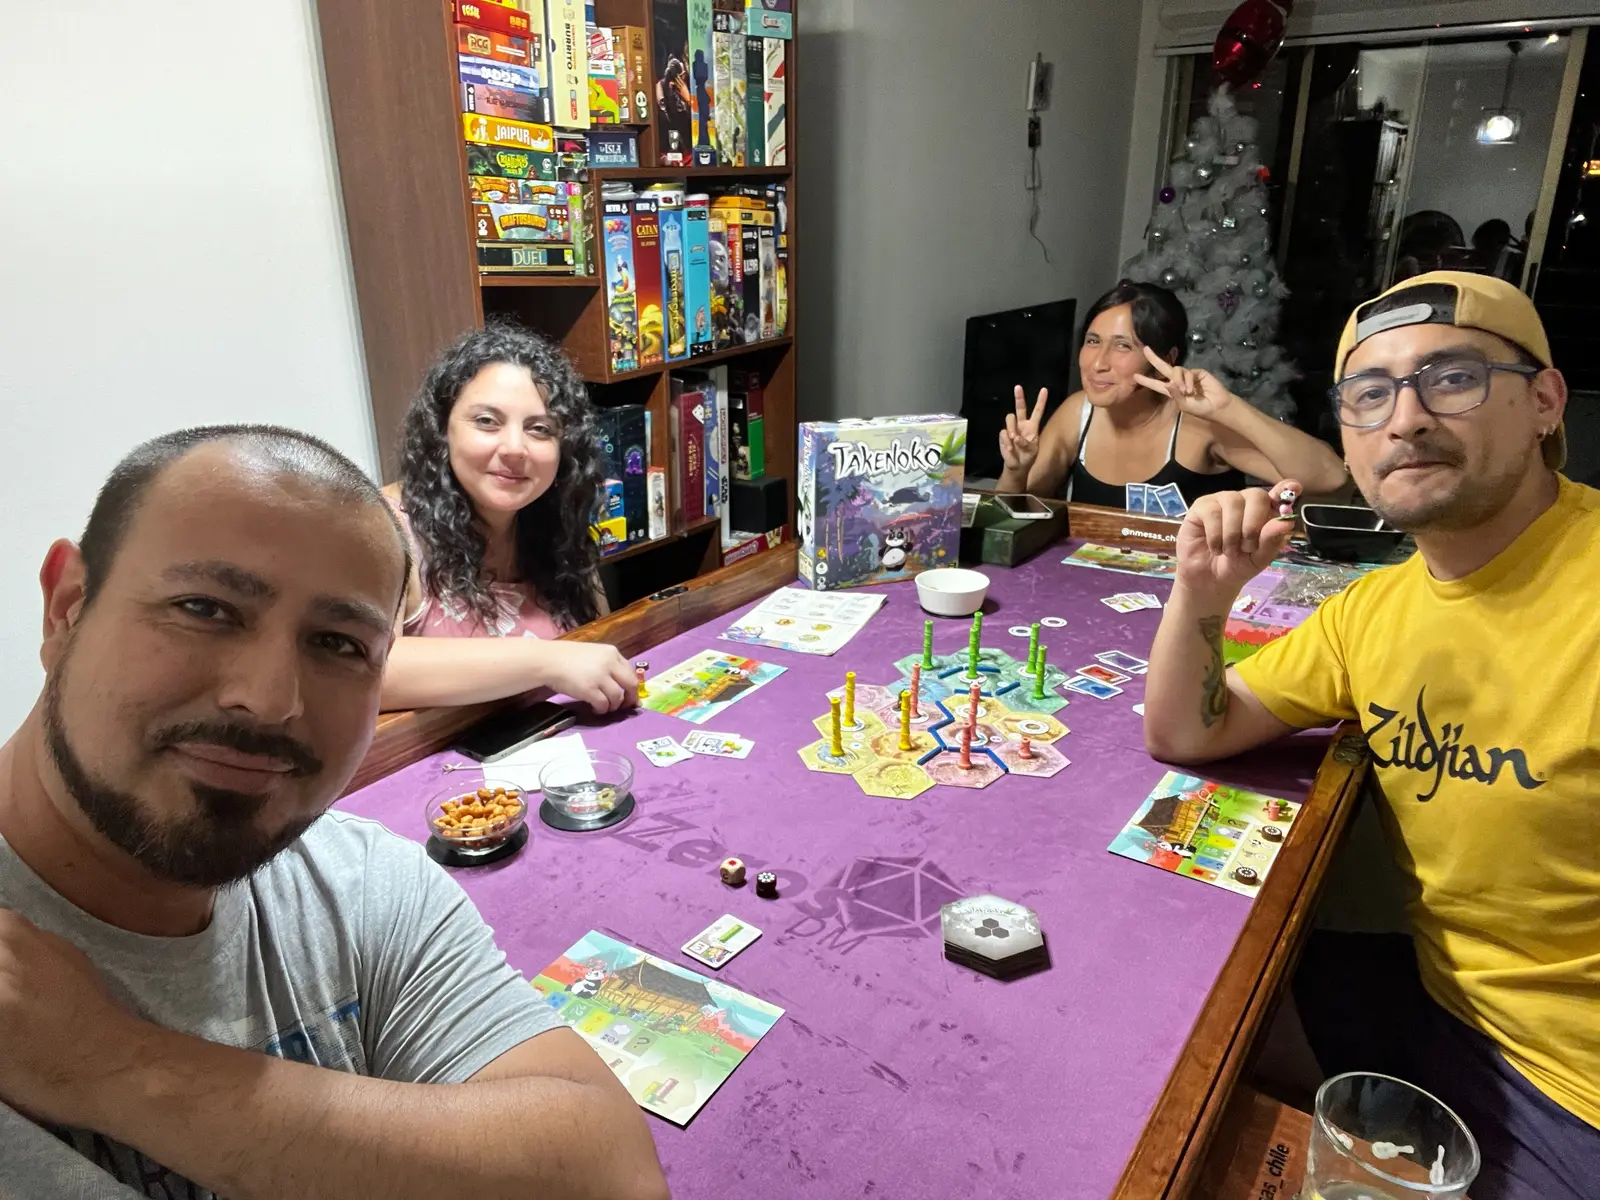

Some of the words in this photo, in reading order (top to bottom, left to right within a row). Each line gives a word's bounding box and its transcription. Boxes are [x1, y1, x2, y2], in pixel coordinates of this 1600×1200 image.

[470, 37, 489, 50] RCG
[564, 22, 573, 70] BURRITO
[494, 125, 531, 145] JAIPUR
[605, 144, 621, 154] ISLA
[500, 213, 548, 230] DRAFTOSAURUS
[636, 225, 658, 237] CATAN
[512, 248, 548, 266] DUEL
[829, 437, 943, 480] TAKENOKO
[1120, 526, 1178, 543] @nmesas_ch
[1364, 684, 1548, 802] Zildjian
